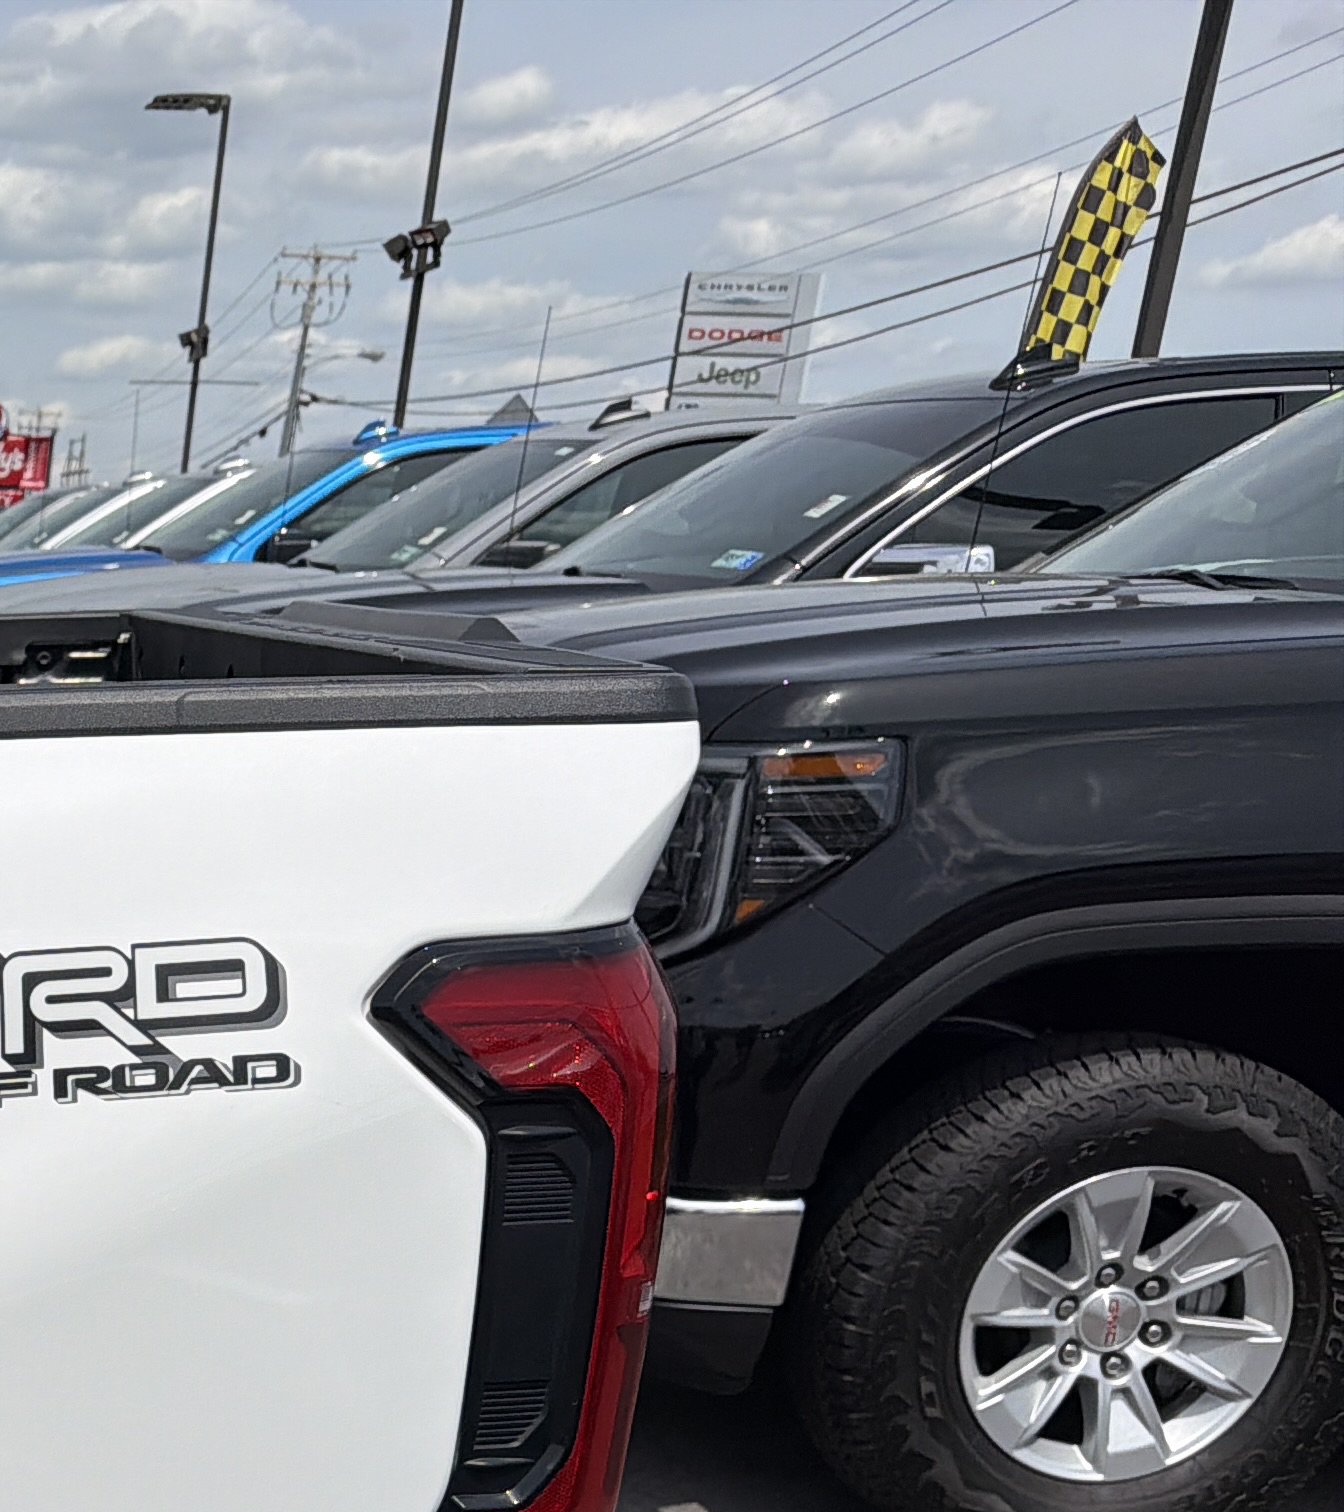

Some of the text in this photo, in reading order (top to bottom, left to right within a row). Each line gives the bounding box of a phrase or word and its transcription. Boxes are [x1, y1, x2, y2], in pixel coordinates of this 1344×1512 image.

[697, 281, 789, 292] CHRYSLER
[686, 327, 784, 343] DODGE
[696, 360, 761, 390] Jeep
[52, 1052, 302, 1105] ROAD
